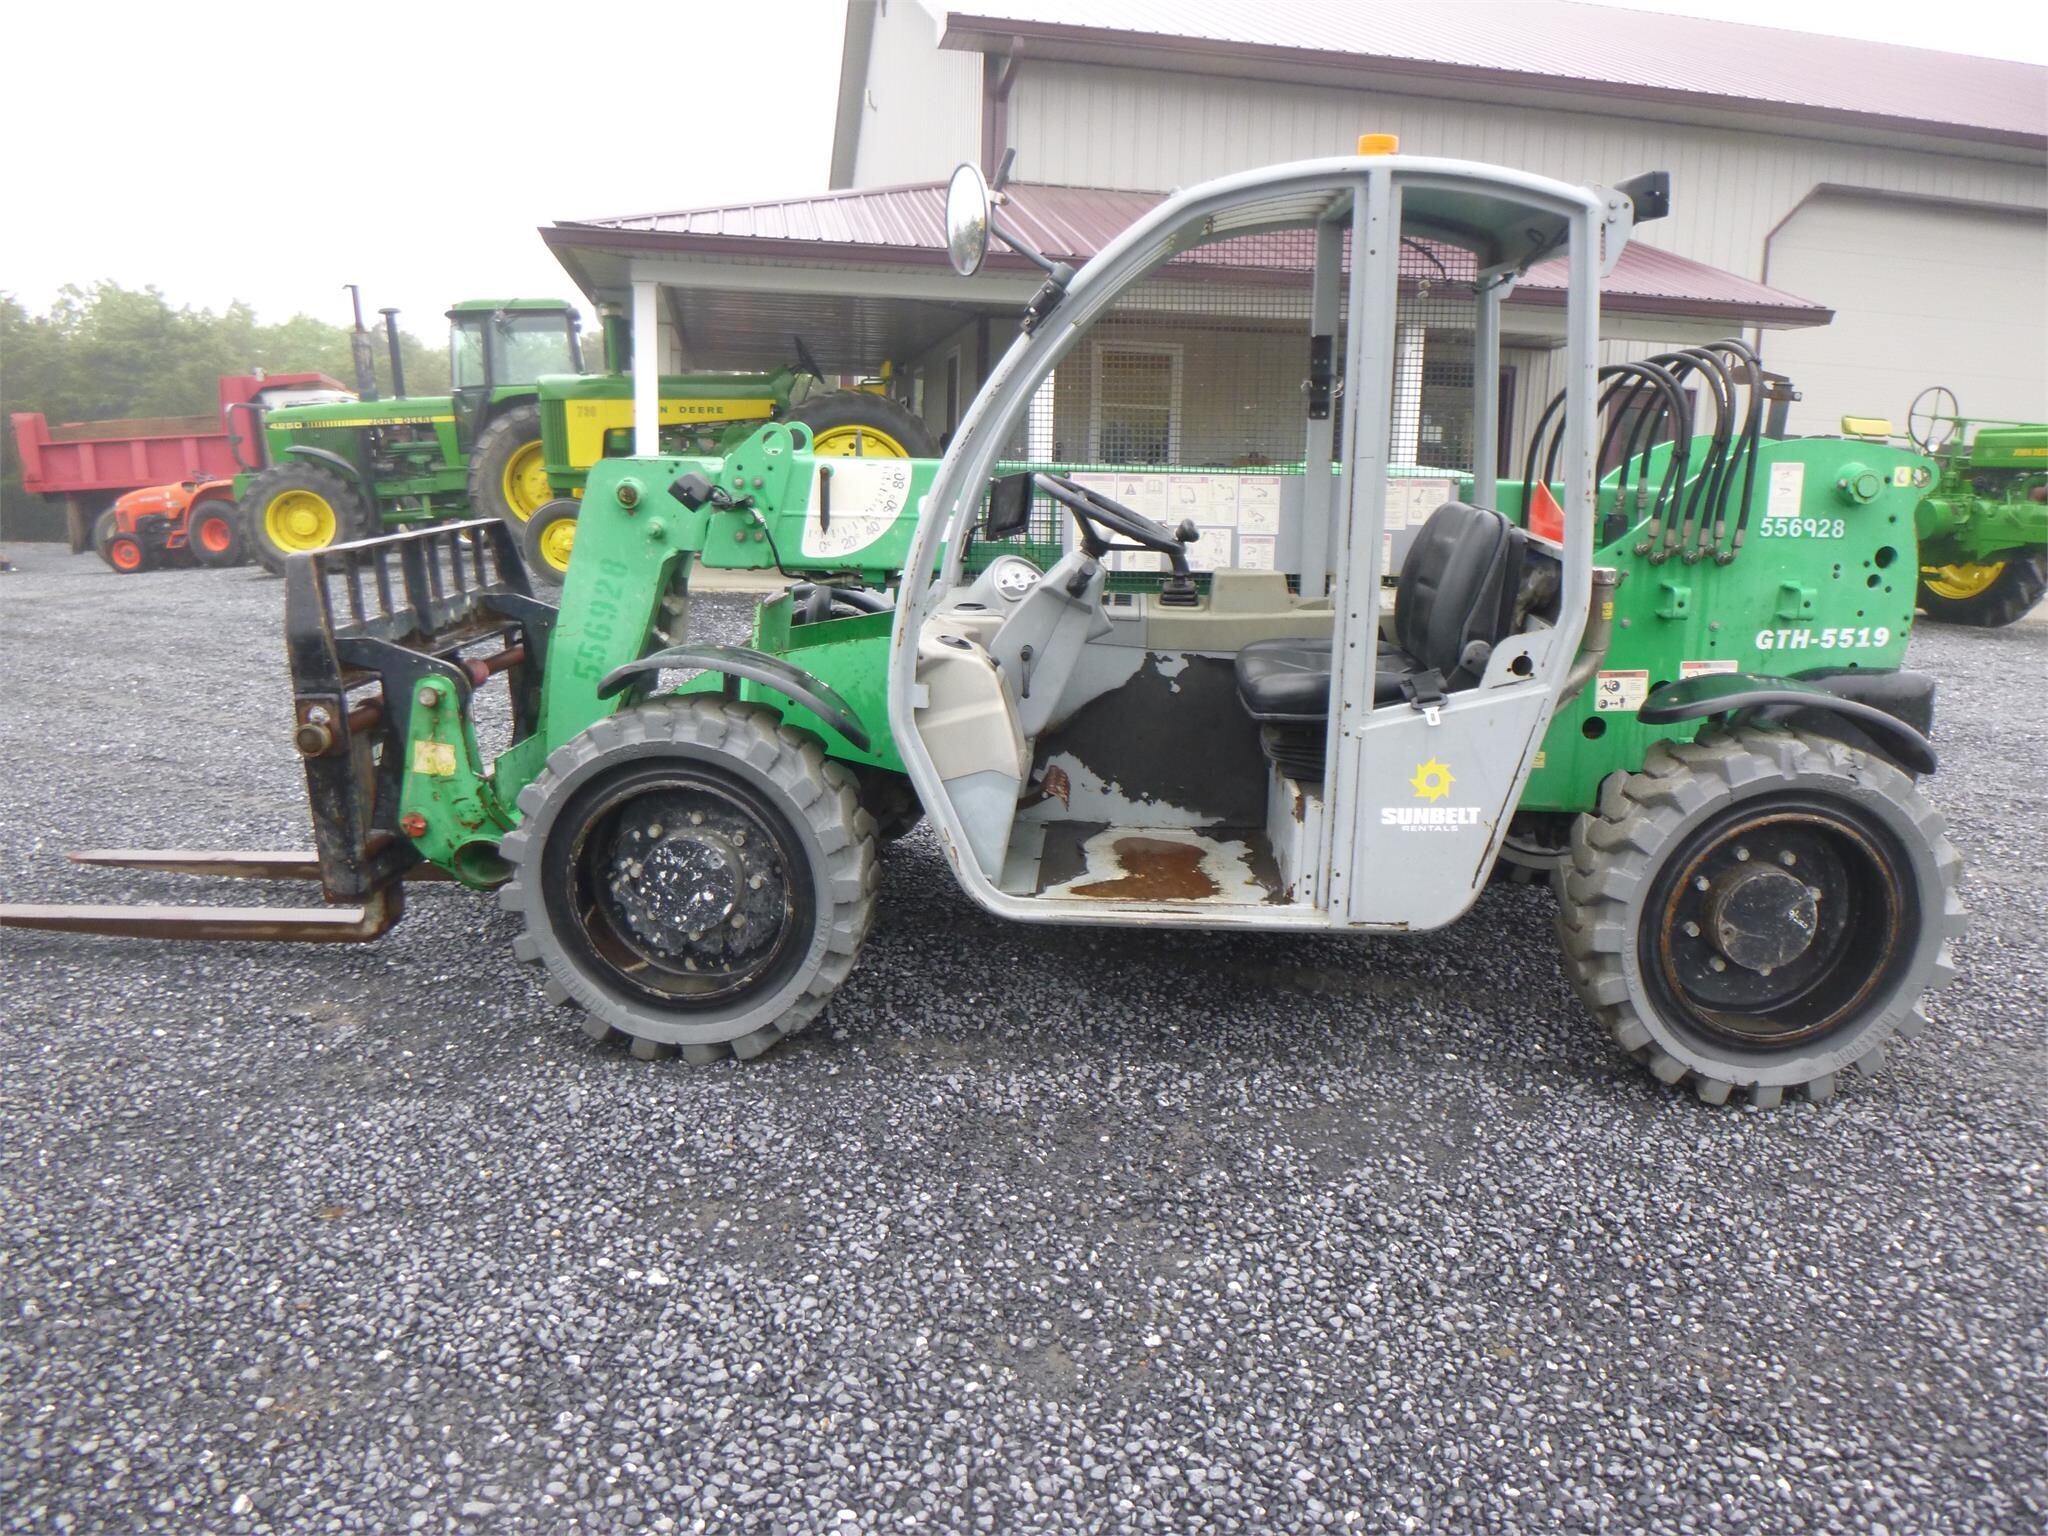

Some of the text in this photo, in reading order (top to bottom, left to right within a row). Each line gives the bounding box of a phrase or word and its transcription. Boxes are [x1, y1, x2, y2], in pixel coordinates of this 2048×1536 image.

[679, 406, 724, 414] DEERE
[1760, 518, 1844, 538] 556928
[1755, 627, 1890, 650] GTH-5519
[1381, 807, 1481, 825] SUNBELT
